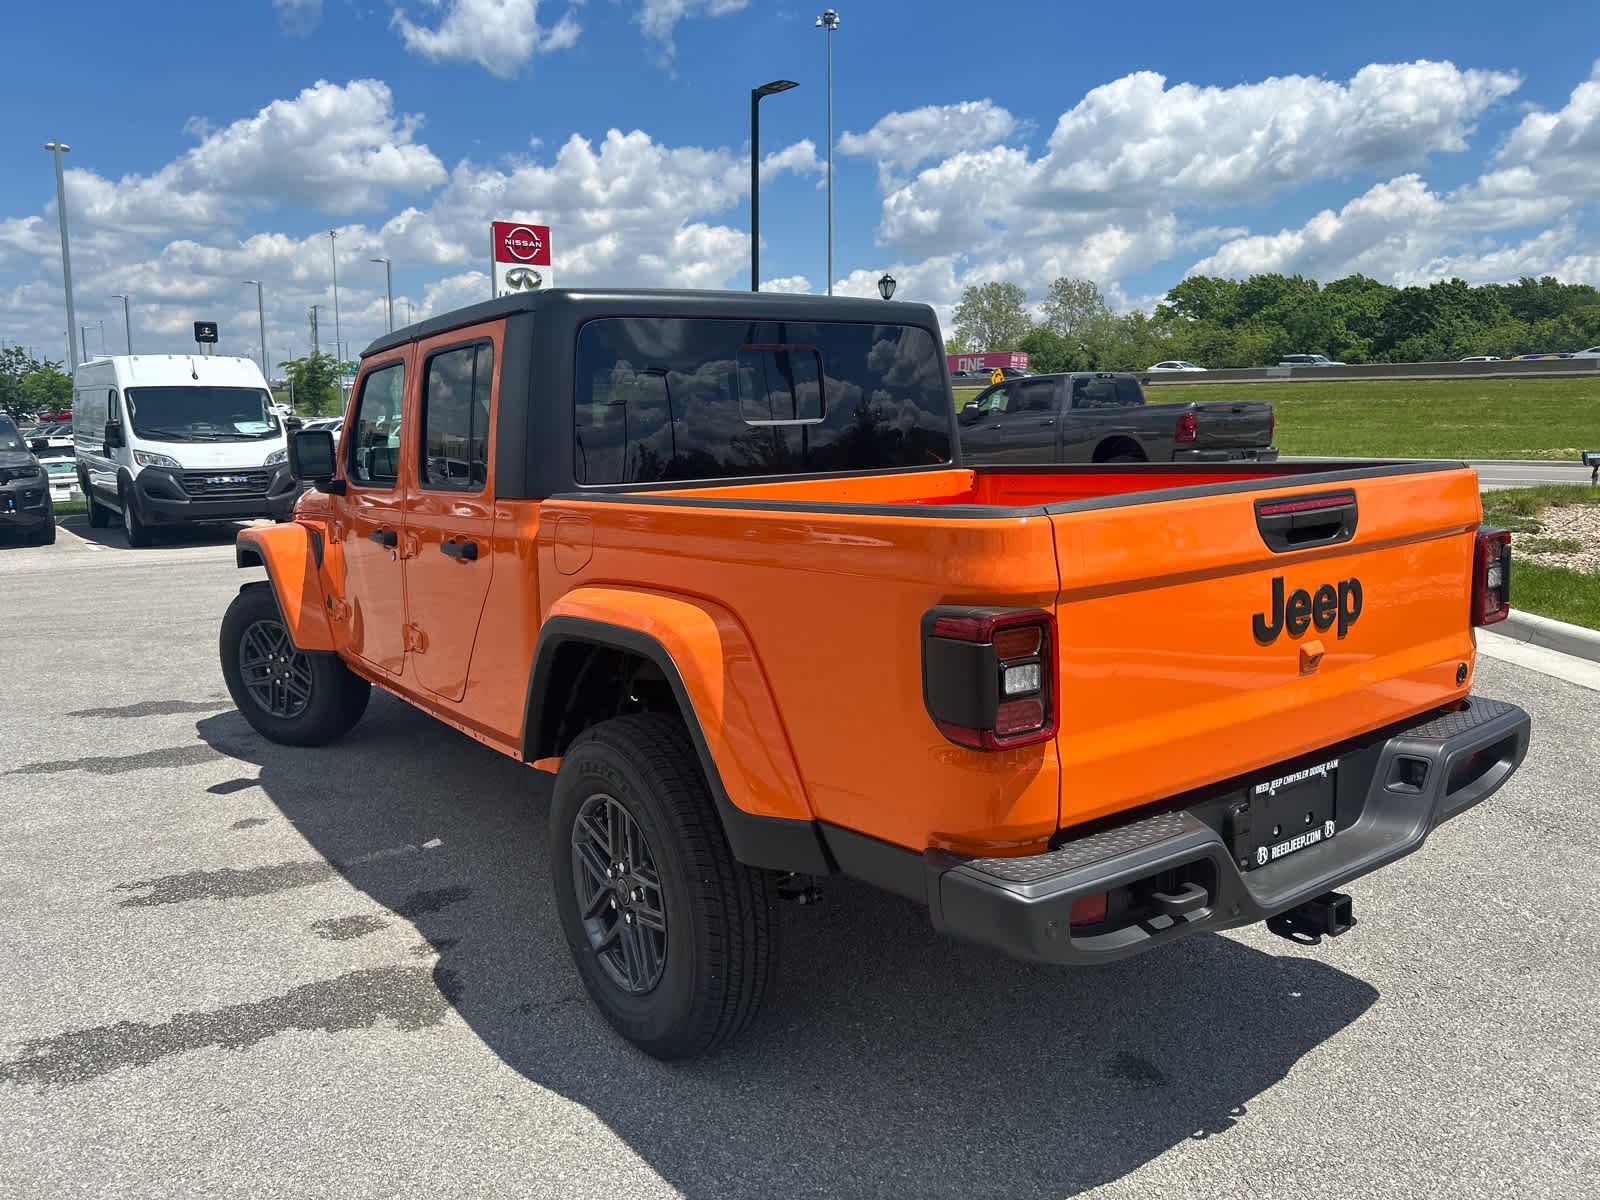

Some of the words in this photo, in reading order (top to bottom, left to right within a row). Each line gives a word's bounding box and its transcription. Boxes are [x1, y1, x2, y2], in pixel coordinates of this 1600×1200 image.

[505, 238, 542, 247] NISSAN
[958, 357, 985, 371] ONE
[1252, 576, 1363, 645] Jeep
[1255, 782, 1269, 794] REED
[1271, 778, 1283, 789] JEEP
[1283, 769, 1309, 785] CHRYSLER
[1309, 765, 1325, 777] DODGE
[1326, 759, 1339, 771] RAM
[1271, 829, 1321, 860] REEDJEEP.COM
